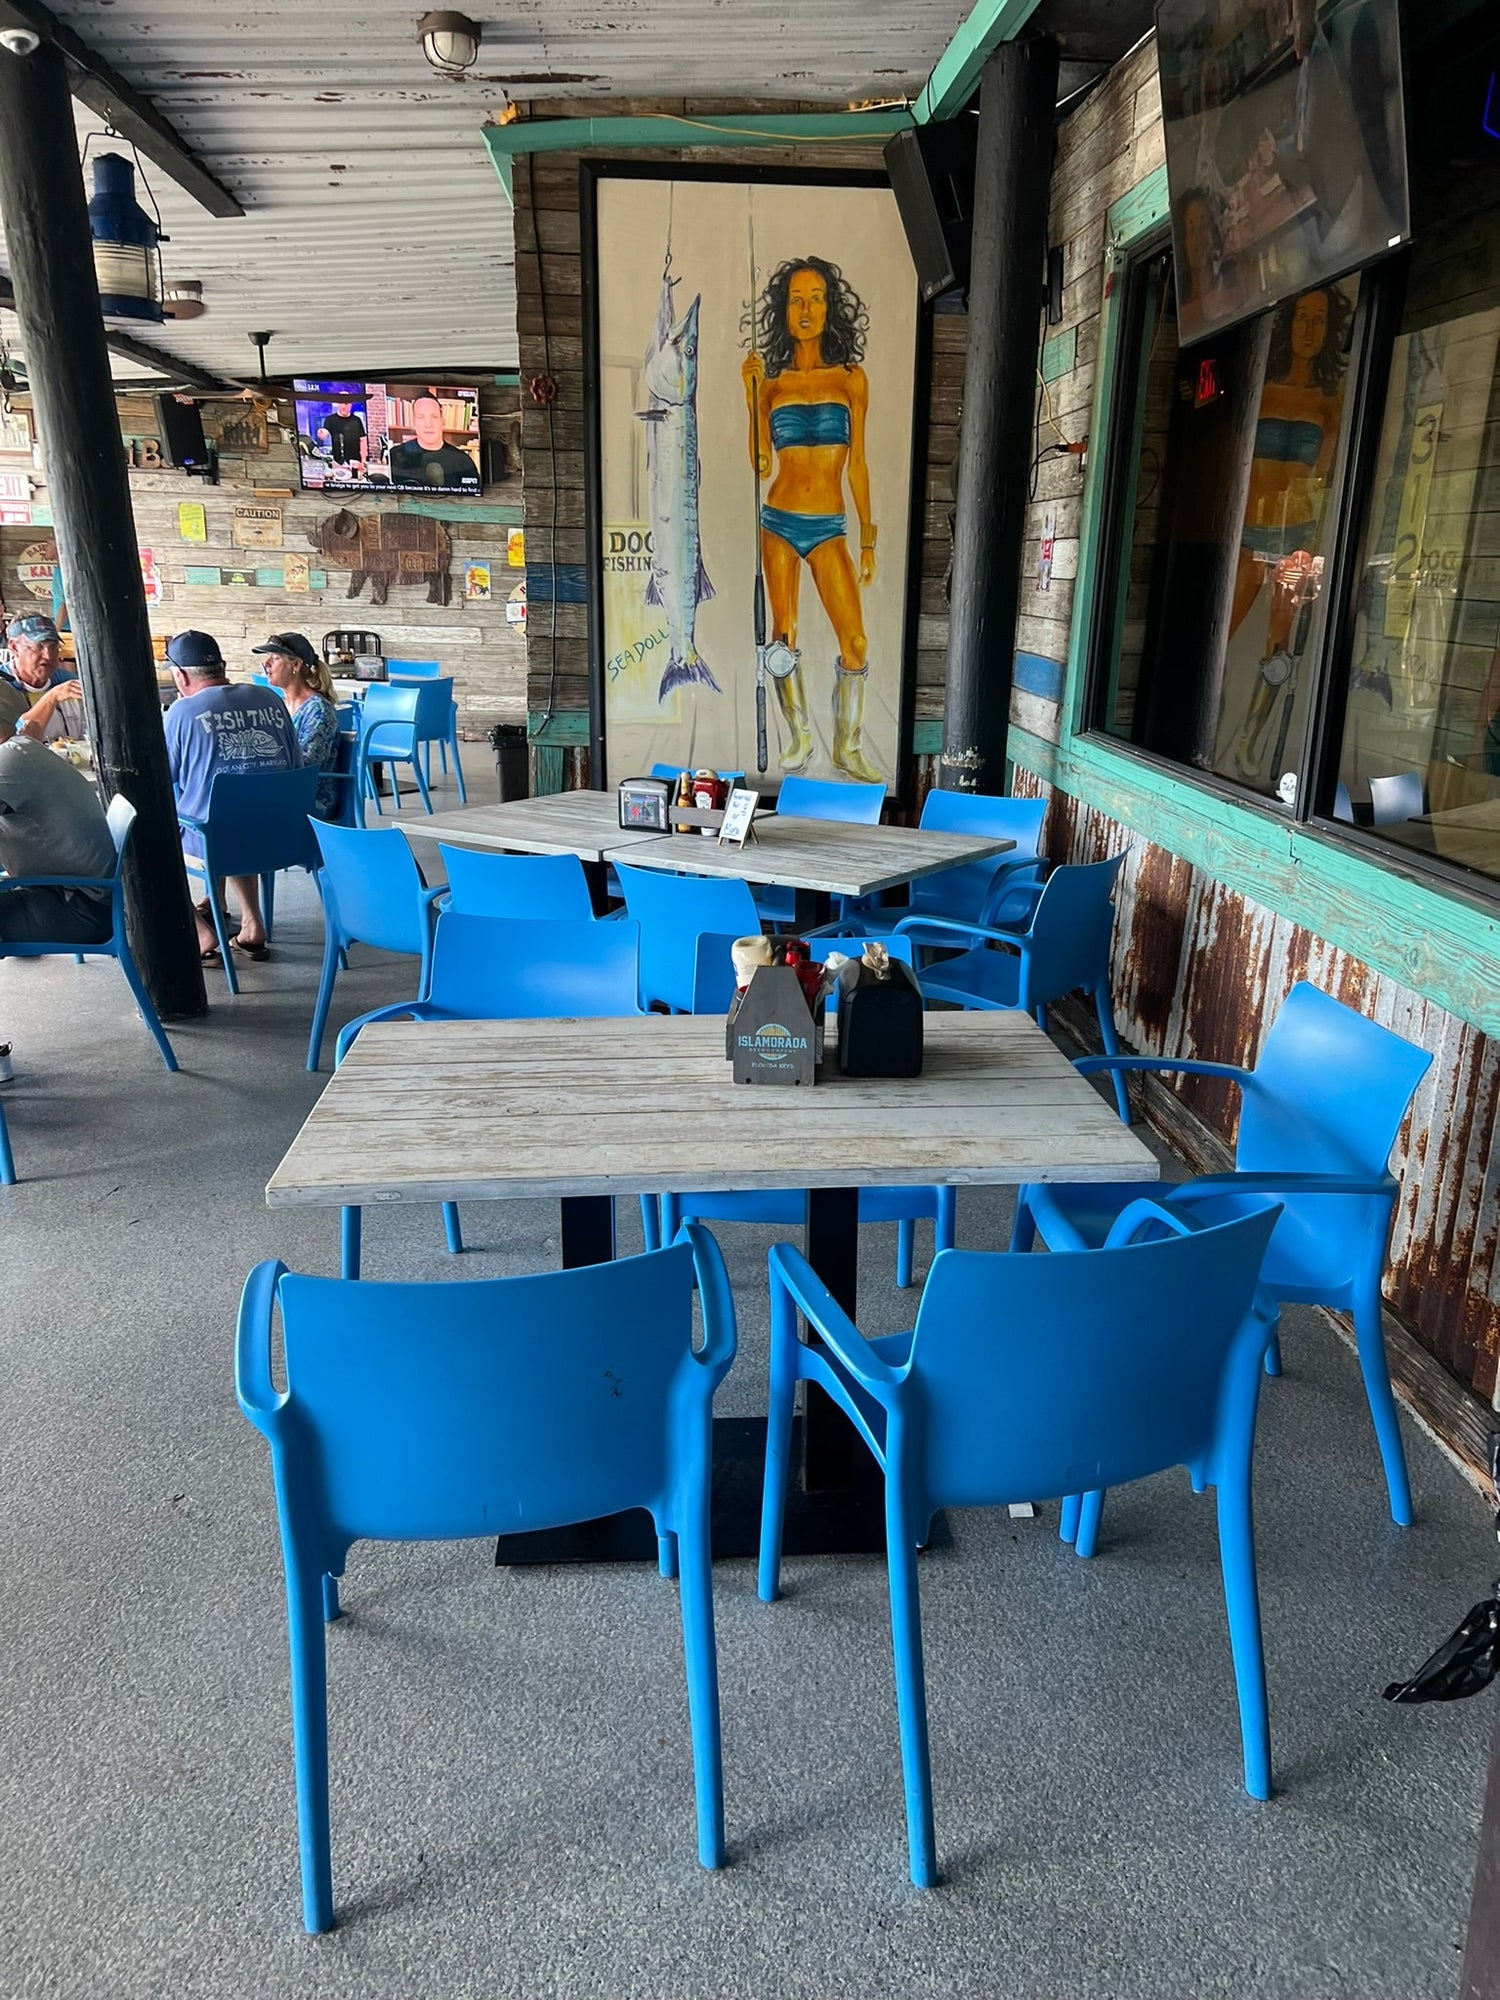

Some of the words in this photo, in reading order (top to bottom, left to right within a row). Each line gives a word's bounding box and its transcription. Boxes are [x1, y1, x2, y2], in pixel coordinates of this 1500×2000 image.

[127, 438, 165, 469] iB
[236, 509, 280, 519] CAUTION
[27, 544, 48, 558] BAH
[30, 566, 53, 577] KAL
[607, 649, 636, 683] SEA
[632, 628, 670, 663] DOLL
[195, 710, 246, 734] FISH
[738, 1036, 808, 1049] ISLAMORADA
